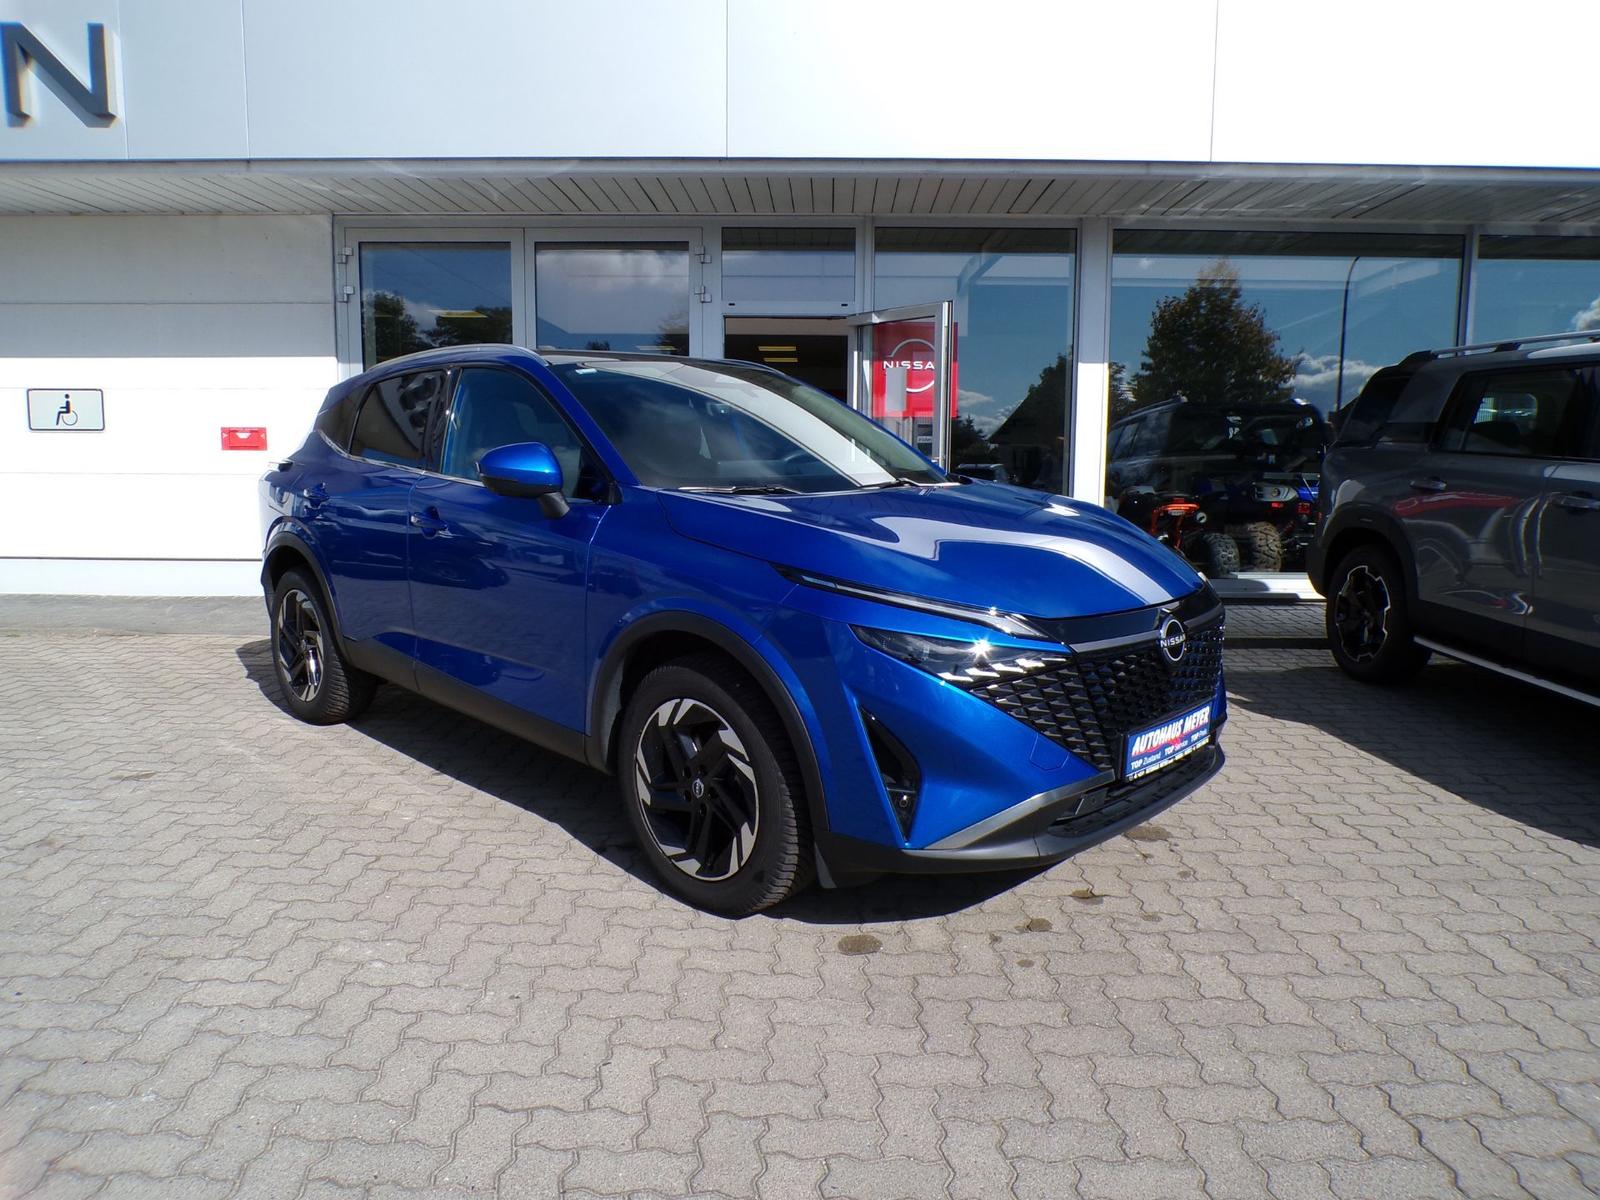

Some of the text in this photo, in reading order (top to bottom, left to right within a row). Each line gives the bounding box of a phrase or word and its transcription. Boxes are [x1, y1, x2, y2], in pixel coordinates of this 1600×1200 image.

[0, 22, 117, 128] N
[883, 360, 935, 370] NISSA
[1160, 633, 1186, 648] NISSAN
[1131, 706, 1210, 757] AUTOHAUS MEYER
[1130, 759, 1144, 770] TOP
[1164, 745, 1176, 756] TOP
